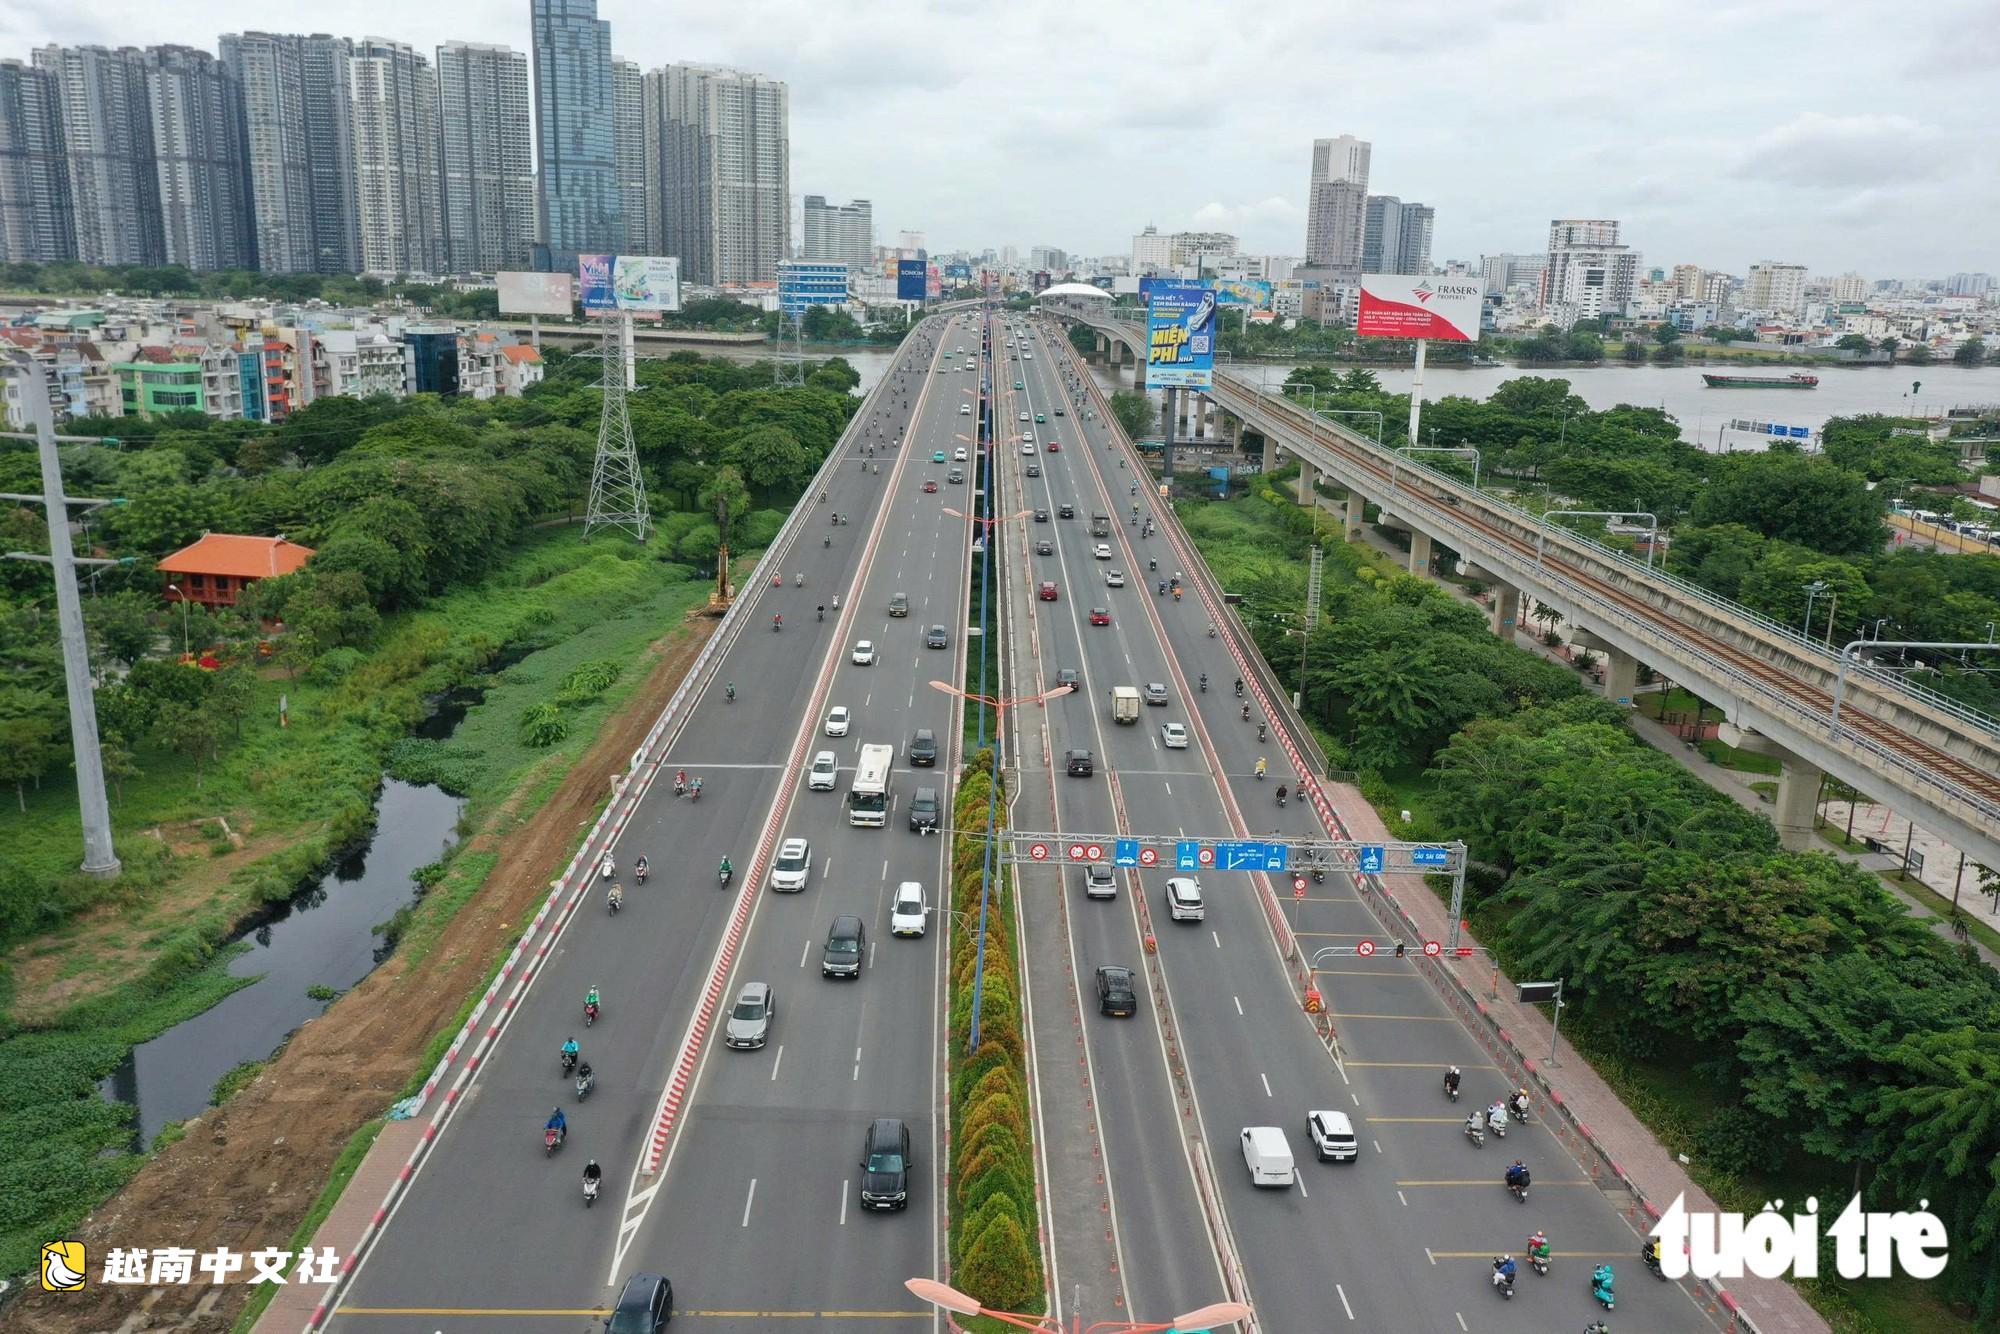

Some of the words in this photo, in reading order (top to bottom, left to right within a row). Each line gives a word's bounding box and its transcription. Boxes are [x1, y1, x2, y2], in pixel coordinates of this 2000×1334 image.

[1438, 285, 1478, 296] FRASERS
[1152, 324, 1189, 345] MIỄN
[1149, 343, 1179, 365] PHÍ
[1090, 848, 1098, 857] 70
